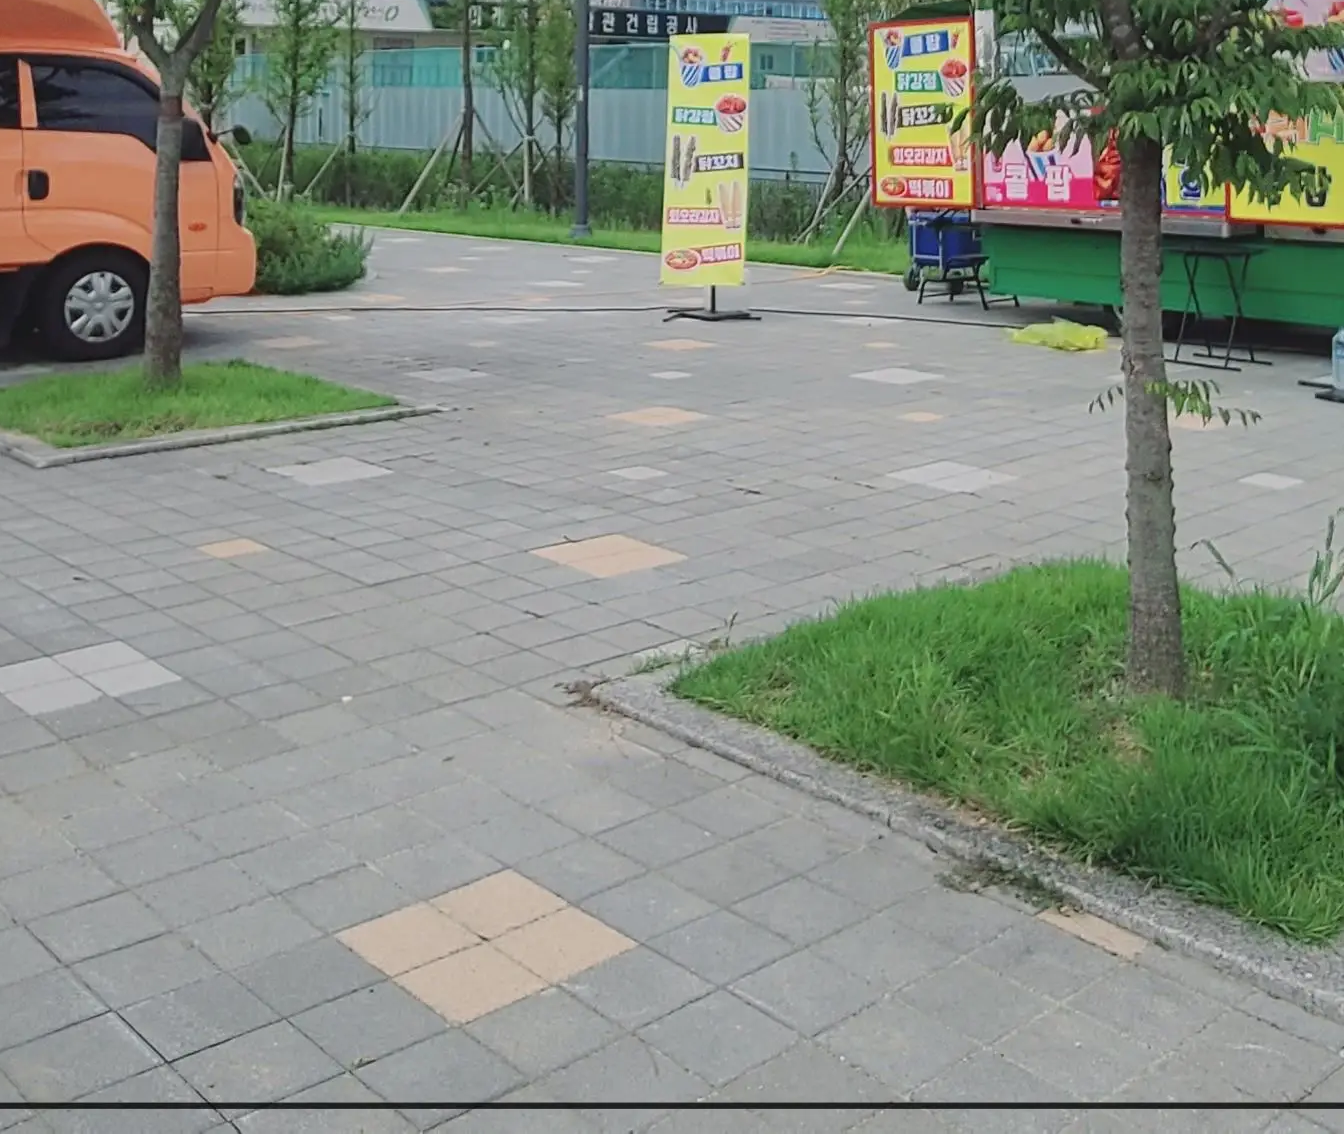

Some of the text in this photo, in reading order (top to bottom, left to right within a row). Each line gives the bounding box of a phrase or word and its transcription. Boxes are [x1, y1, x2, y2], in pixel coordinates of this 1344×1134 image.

[698, 153, 739, 171] 닭꼬치
[893, 147, 948, 164] 회오리감자
[908, 179, 950, 199] 떡볶이
